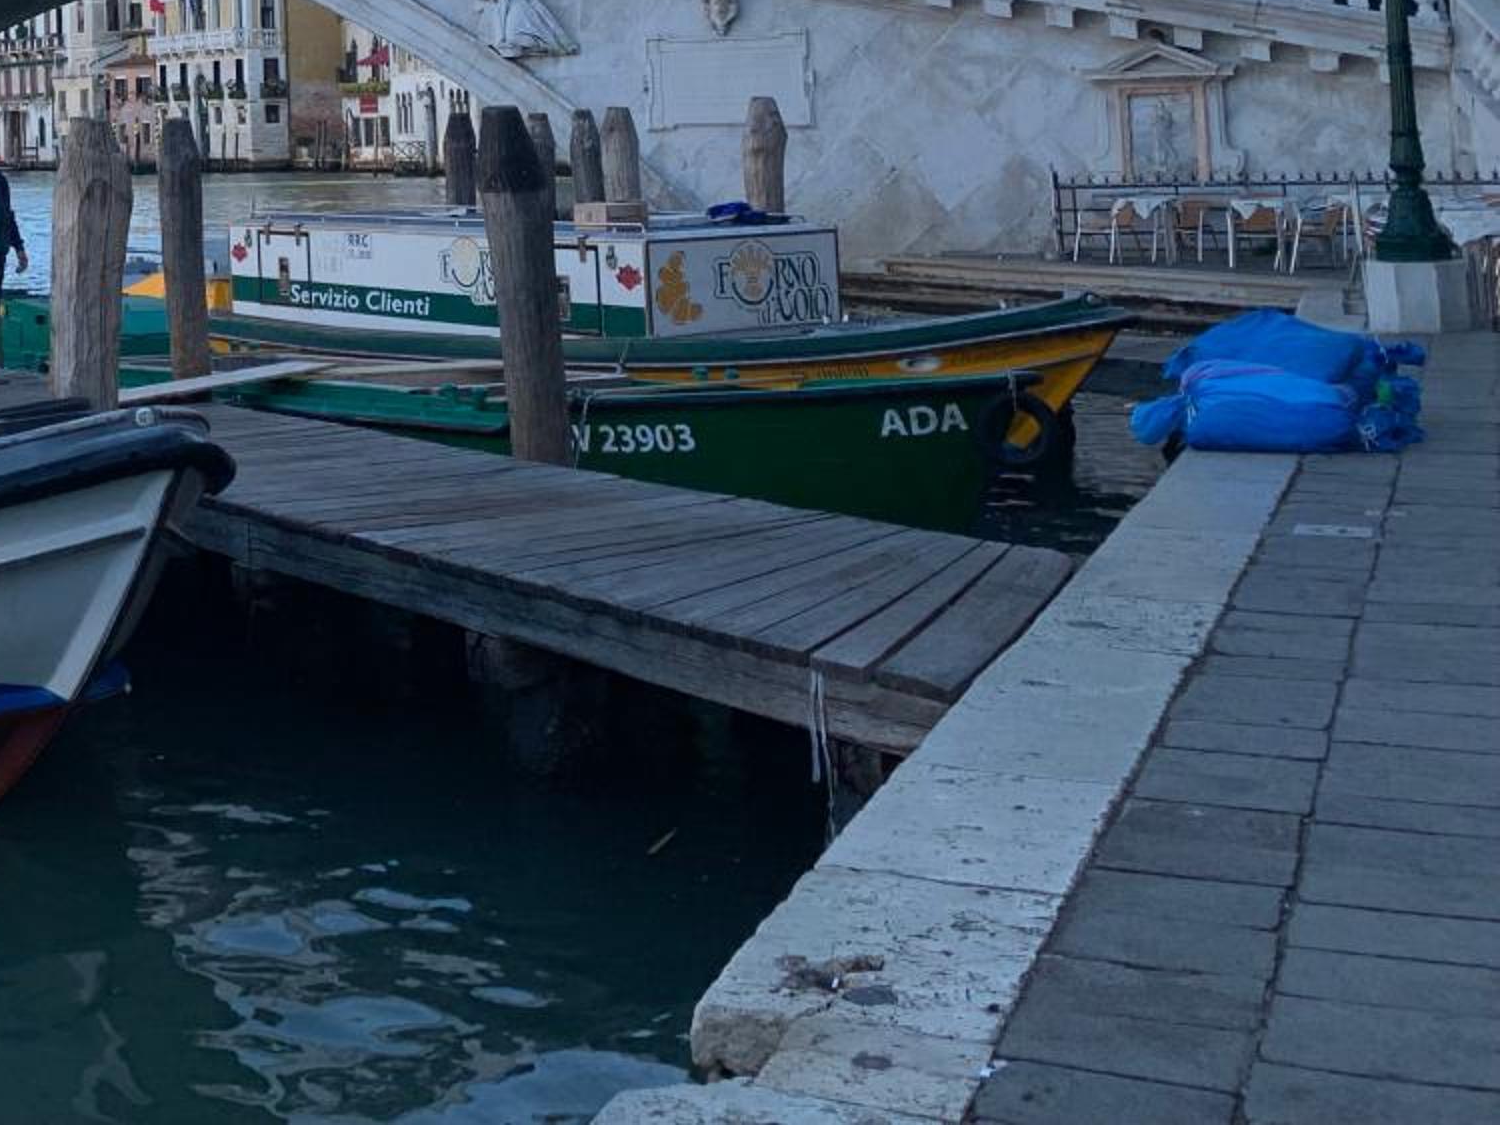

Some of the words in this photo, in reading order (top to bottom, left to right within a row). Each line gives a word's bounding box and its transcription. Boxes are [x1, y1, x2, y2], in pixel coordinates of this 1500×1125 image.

[290, 286, 358, 309] Servizio
[366, 291, 431, 316] Clienti
[881, 402, 969, 438] ADA
[598, 423, 696, 453] 23903
